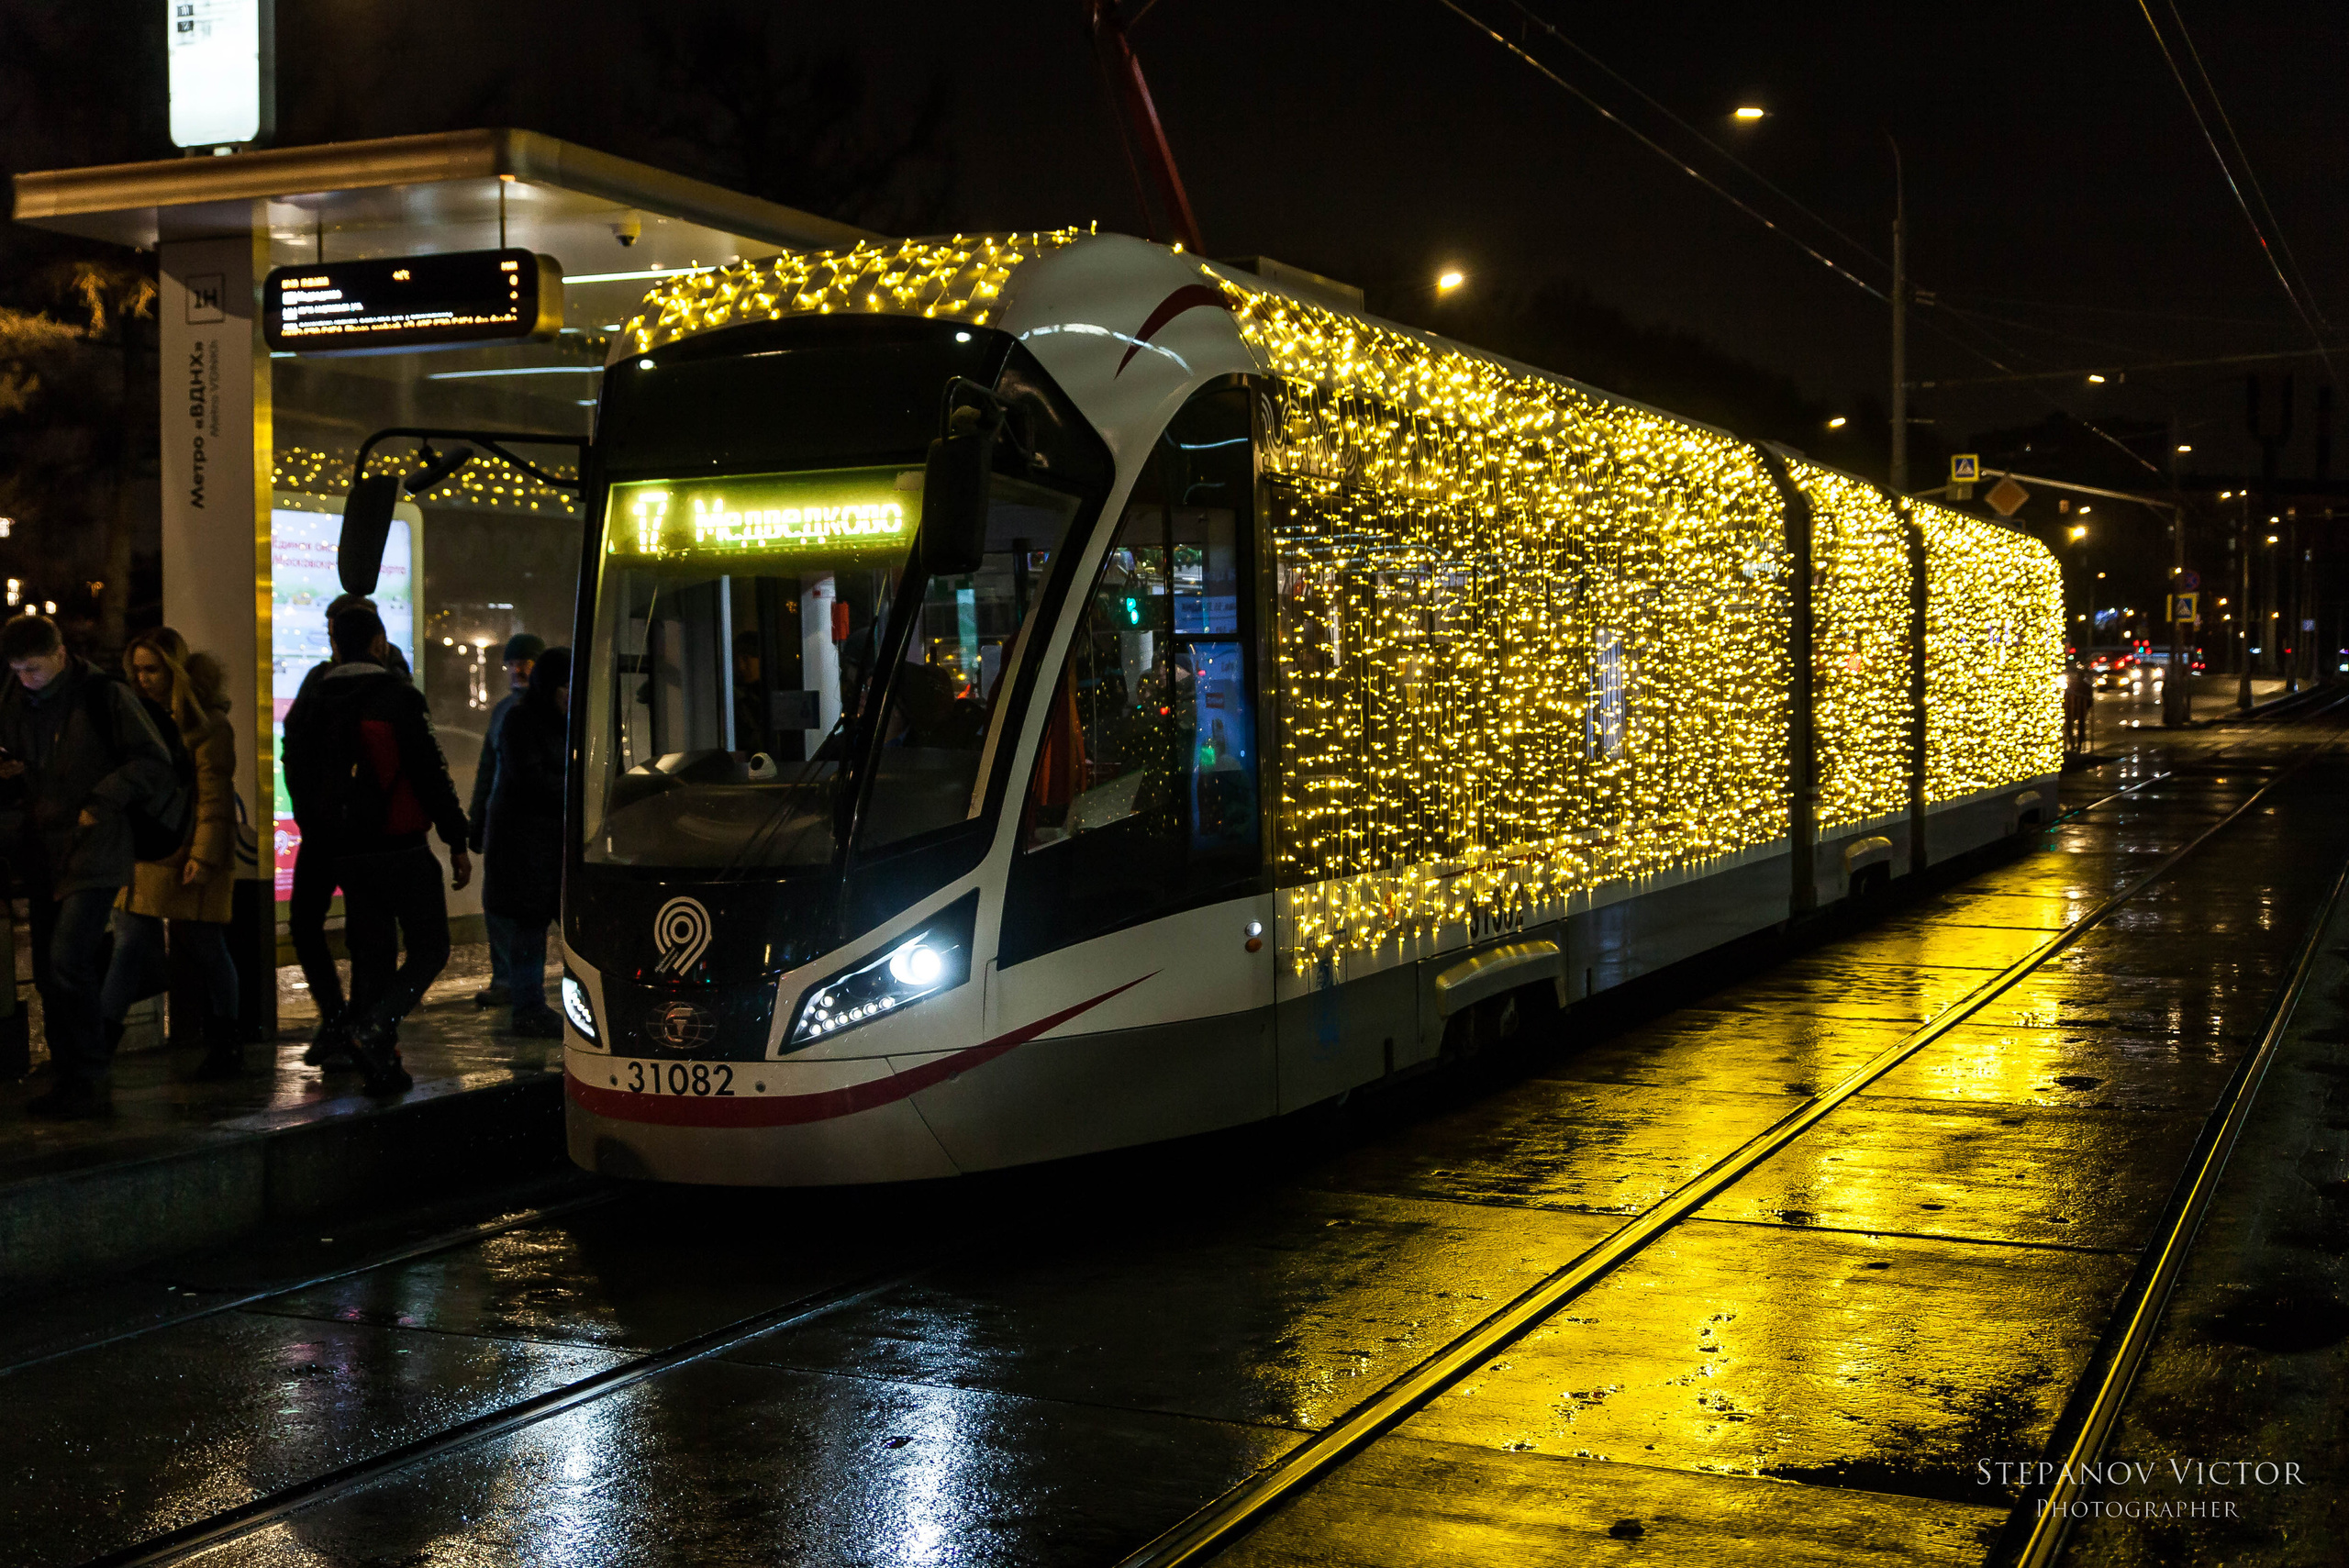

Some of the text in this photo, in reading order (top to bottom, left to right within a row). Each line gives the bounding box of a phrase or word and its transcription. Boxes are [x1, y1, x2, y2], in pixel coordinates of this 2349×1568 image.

[189, 340, 206, 509] Метро «ВДНХ»
[632, 492, 903, 552] 17 Медведково
[628, 1061, 734, 1096] 31082
